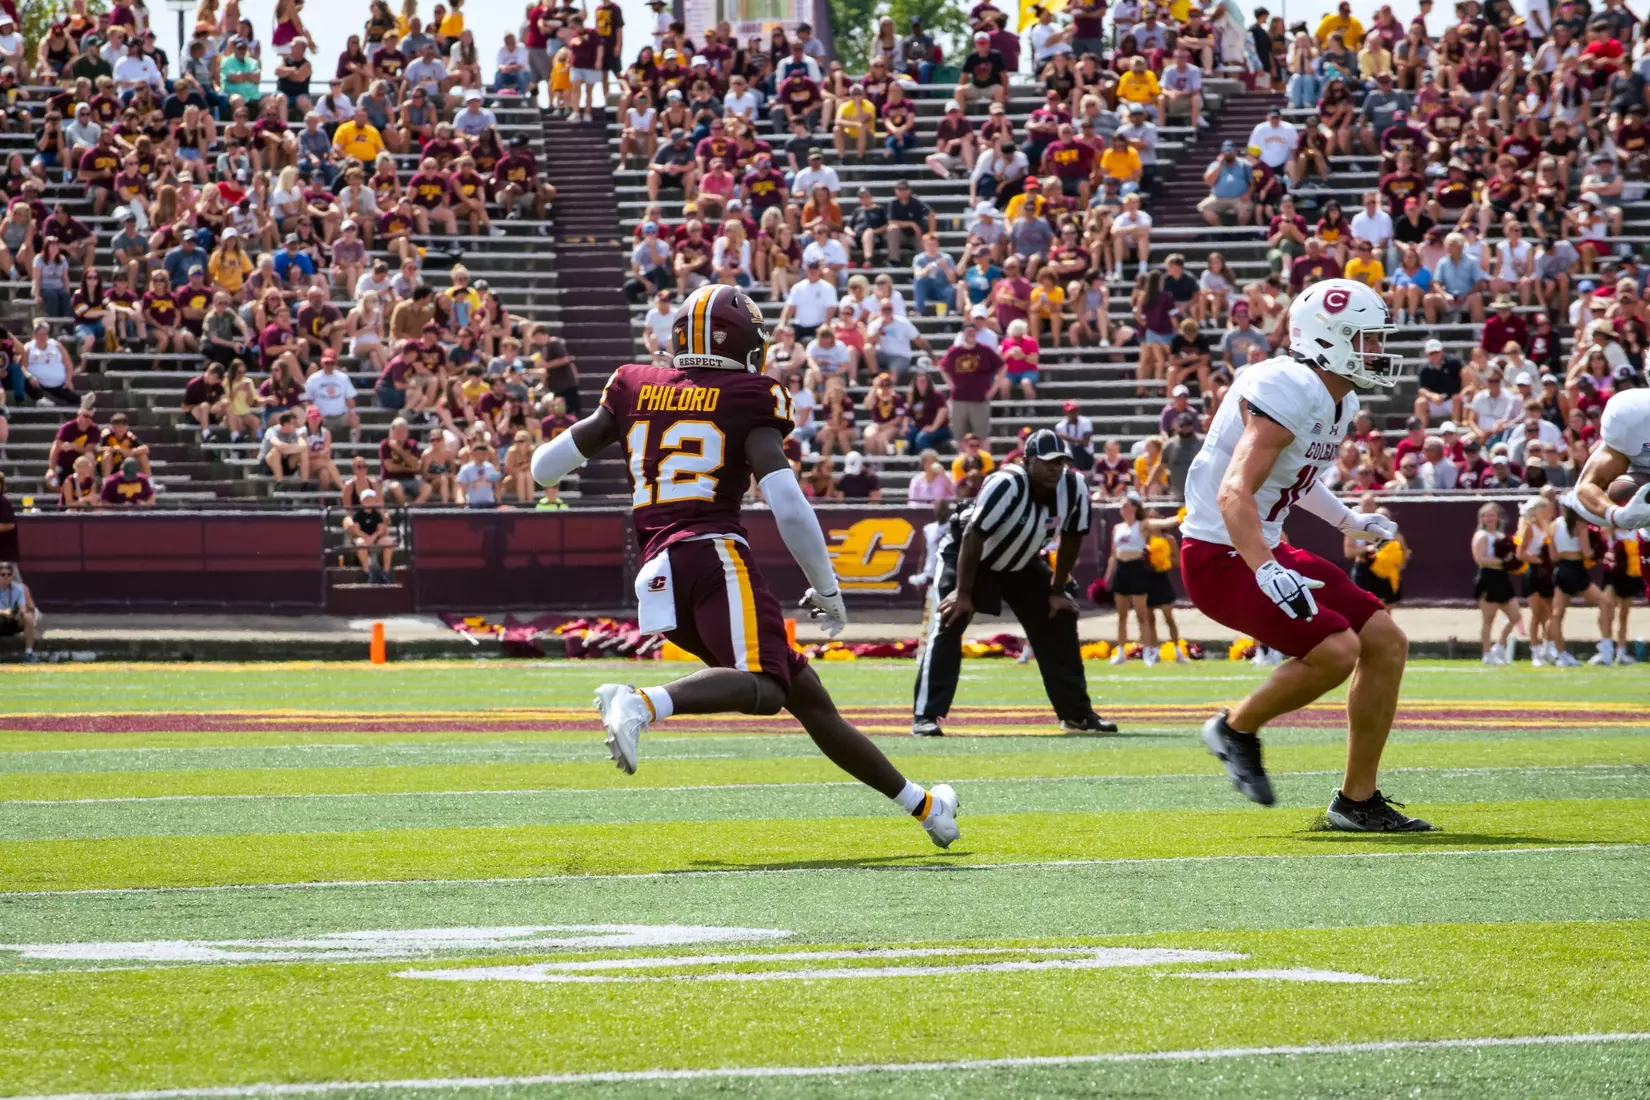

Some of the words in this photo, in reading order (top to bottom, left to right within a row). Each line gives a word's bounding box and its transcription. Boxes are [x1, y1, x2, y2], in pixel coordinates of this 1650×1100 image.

[1326, 292, 1346, 307] C
[679, 357, 724, 367] RESPECT
[637, 384, 720, 412] PHILORD
[626, 419, 726, 509] 12
[828, 518, 915, 584] C
